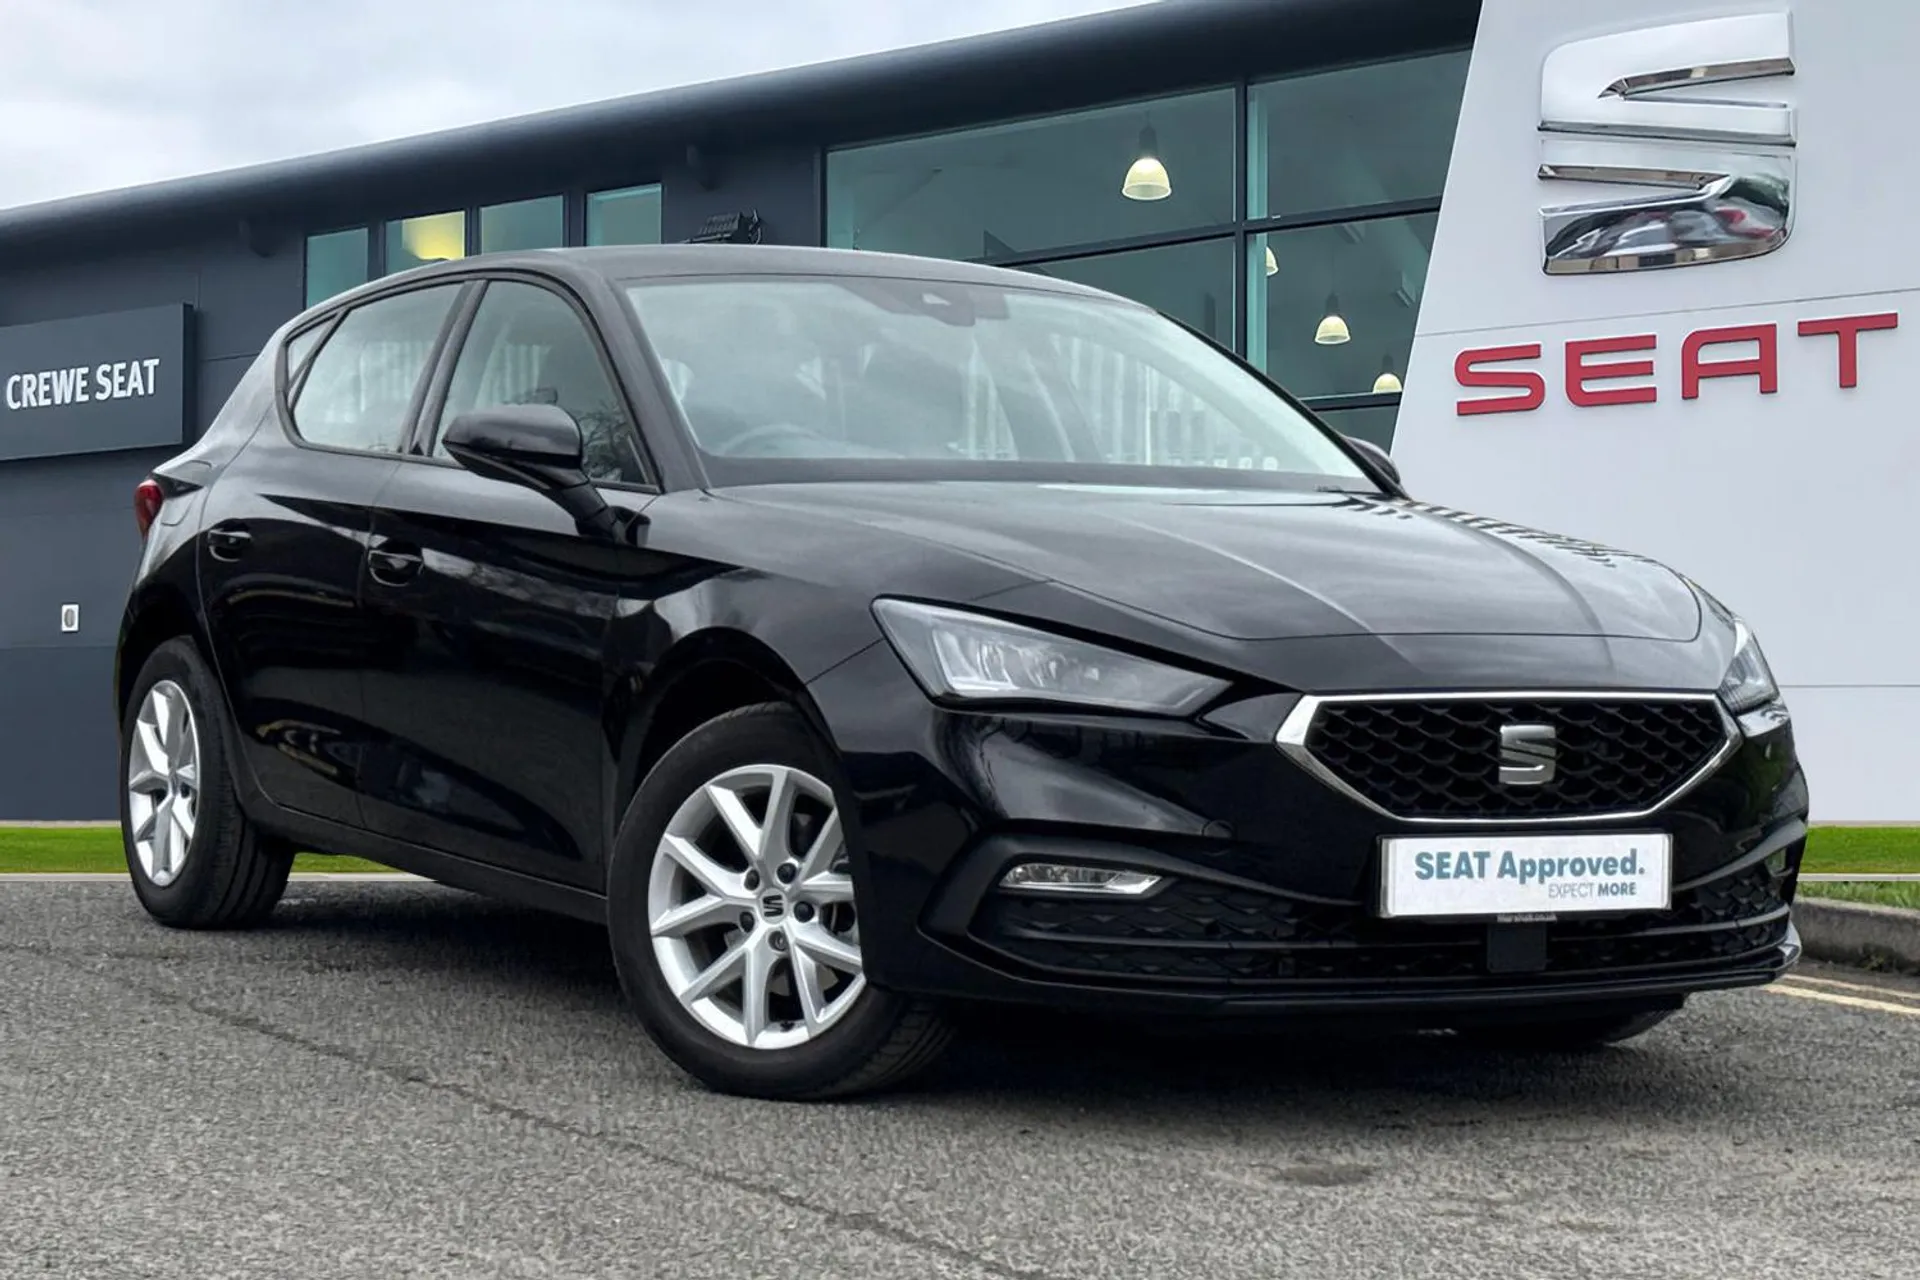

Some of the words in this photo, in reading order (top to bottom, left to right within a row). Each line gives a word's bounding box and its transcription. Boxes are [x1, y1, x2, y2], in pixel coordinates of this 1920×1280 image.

[6, 367, 90, 410] CREWE
[95, 358, 160, 400] SEAT
[1454, 312, 1898, 416] SEAT
[1415, 851, 1491, 880] SEAT
[1497, 848, 1646, 885] Approved.
[1549, 882, 1594, 899] EXPECT
[1597, 881, 1637, 897] MORE
